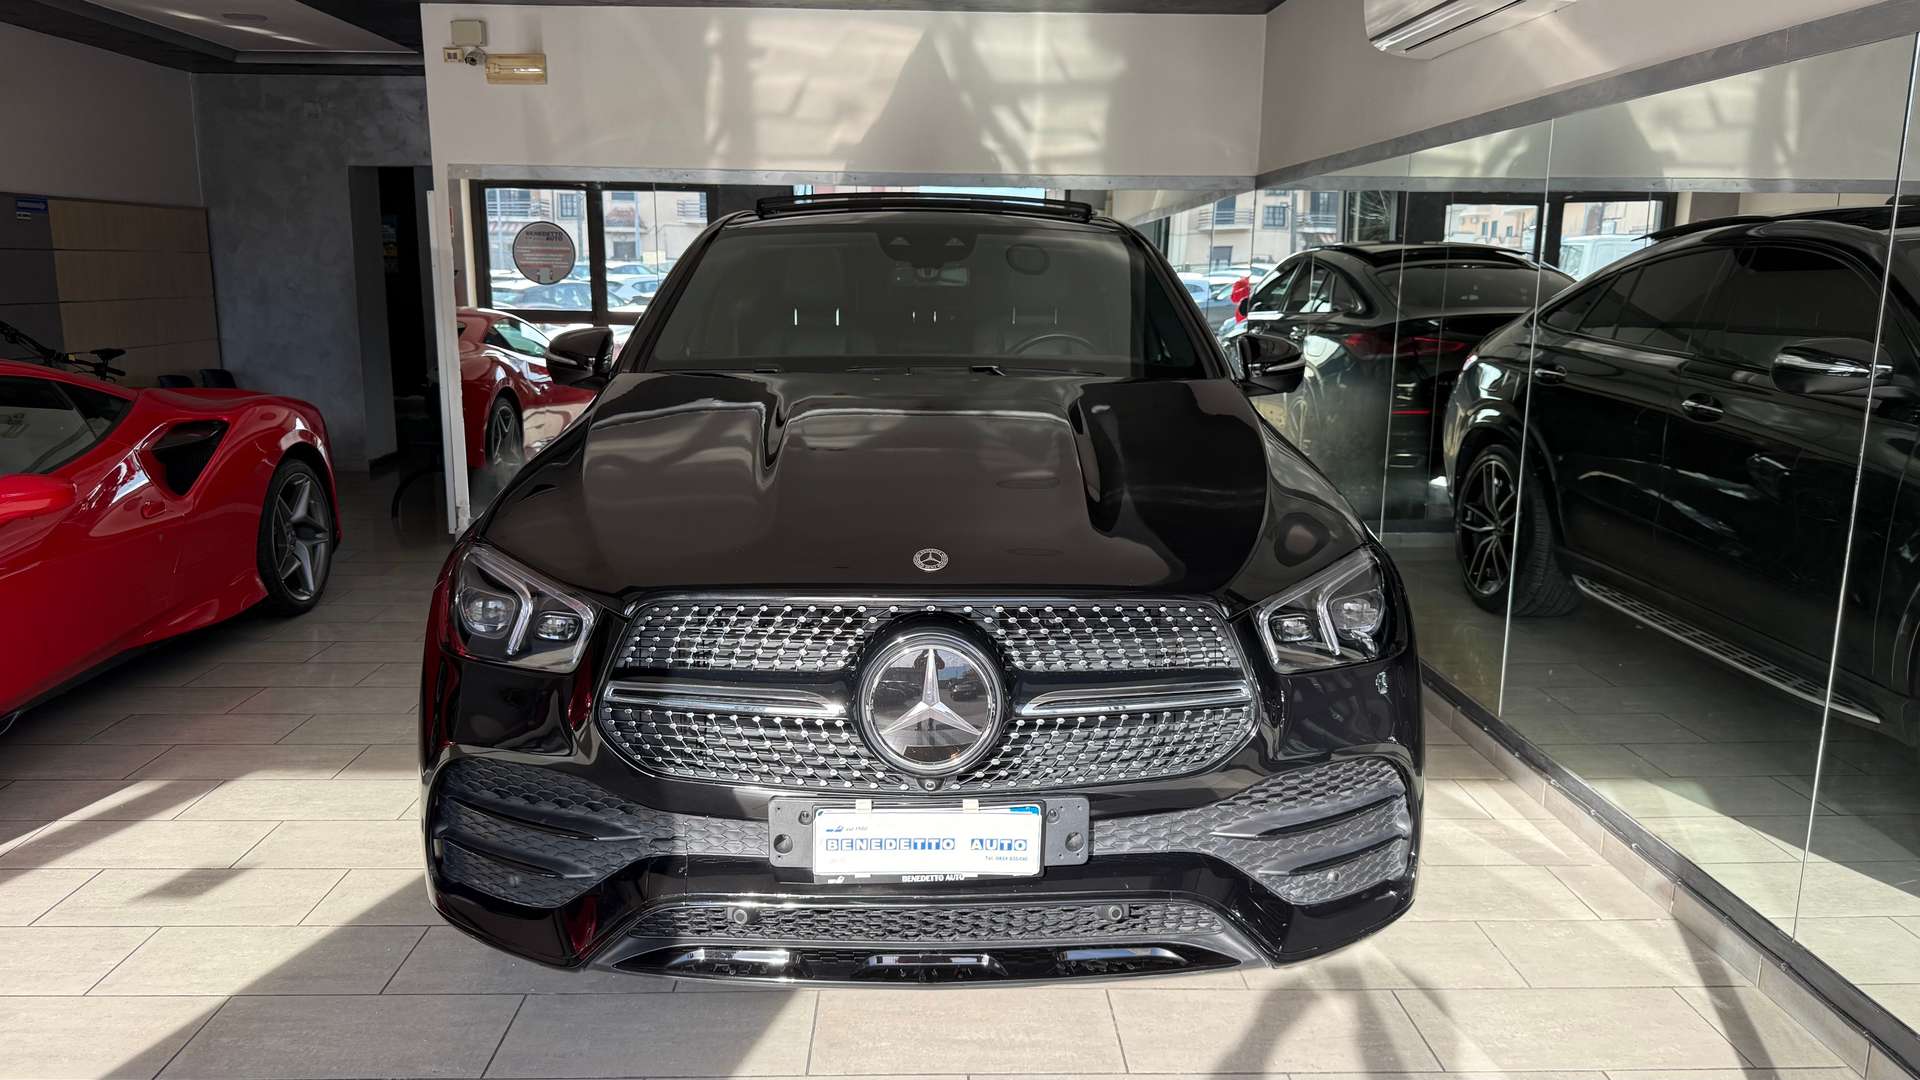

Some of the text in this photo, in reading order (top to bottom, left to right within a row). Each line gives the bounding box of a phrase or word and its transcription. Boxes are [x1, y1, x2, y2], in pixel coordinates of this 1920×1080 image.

[826, 838, 1027, 851] BENEDETTO AUTO
[945, 873, 964, 881] AUTO
